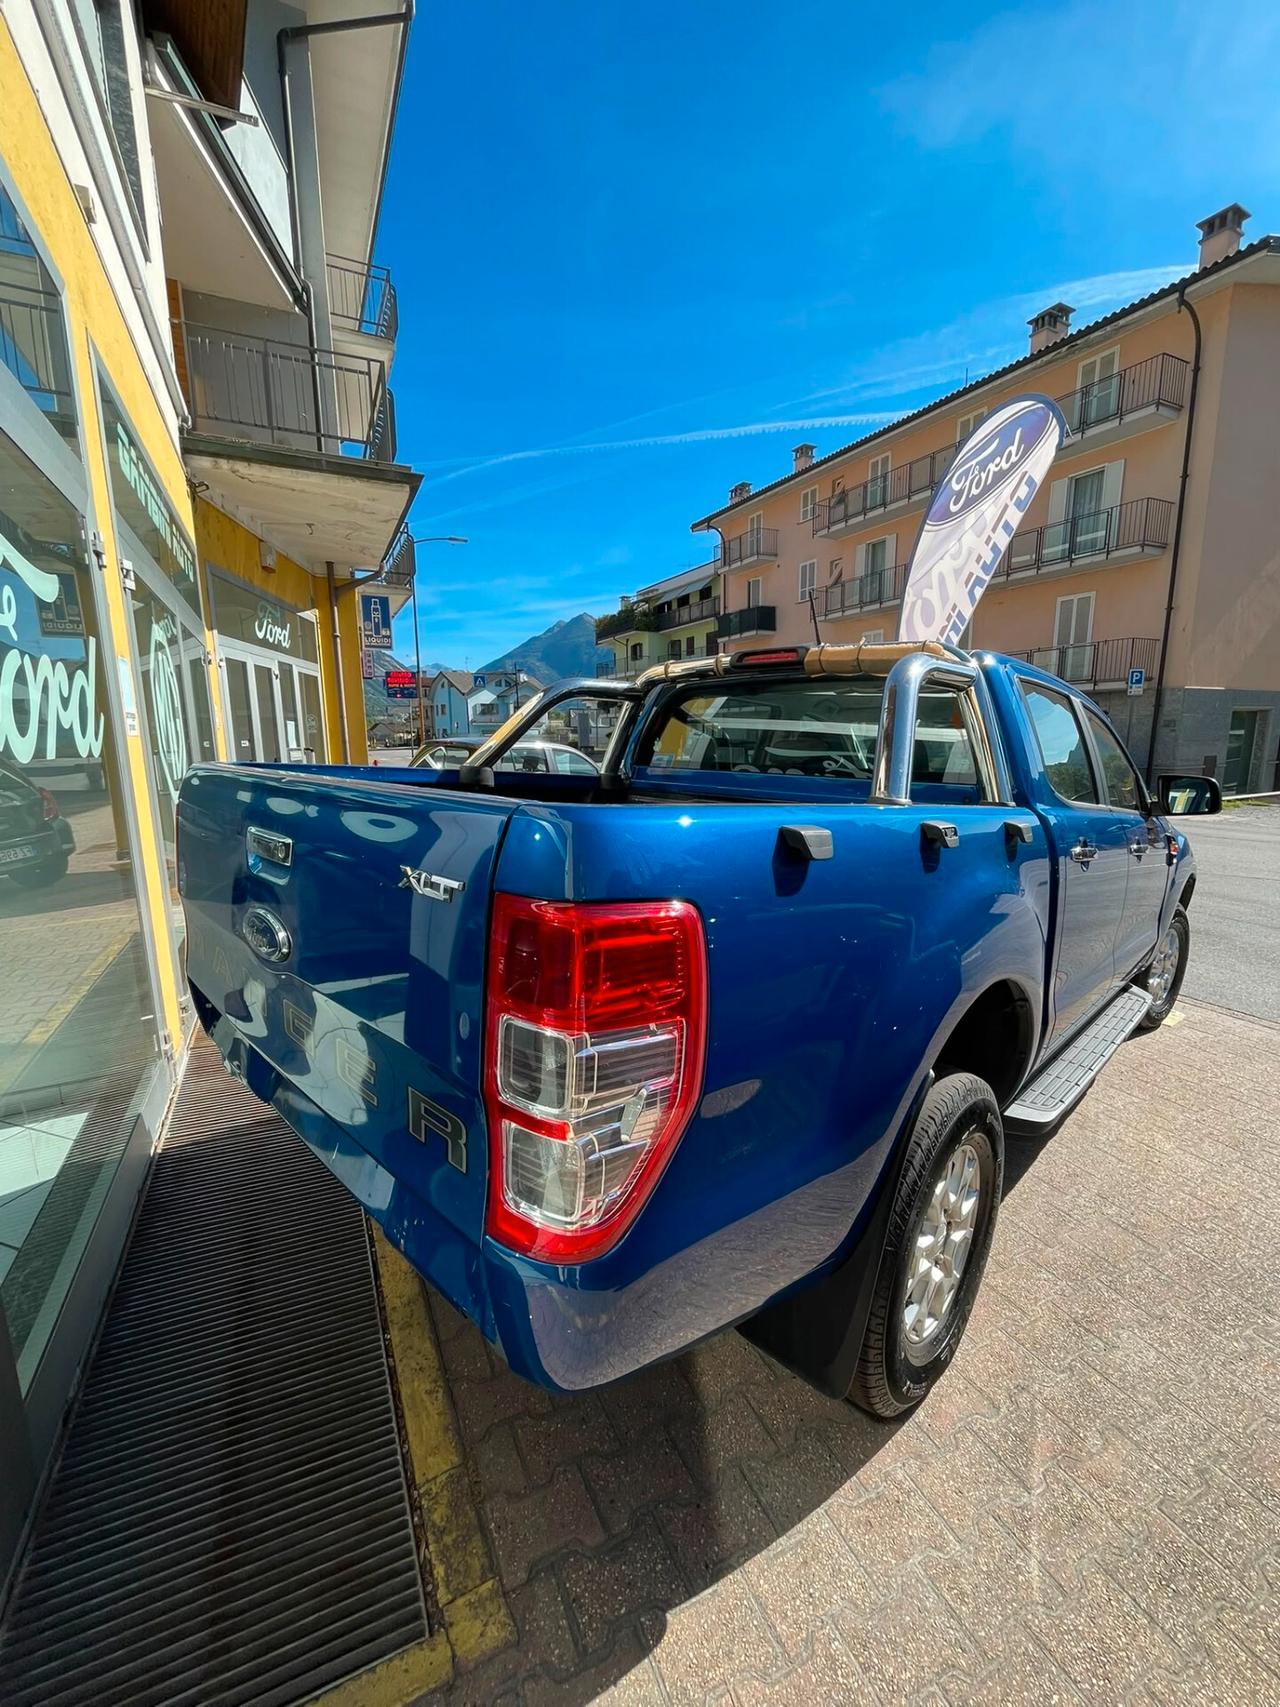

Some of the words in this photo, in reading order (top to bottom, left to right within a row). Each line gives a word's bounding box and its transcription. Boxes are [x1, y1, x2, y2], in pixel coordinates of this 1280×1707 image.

[950, 428, 1025, 513] Ford
[964, 471, 1038, 608] AUTO
[255, 601, 291, 649] Ford
[1133, 672, 1141, 683] P
[398, 865, 466, 904] XLT
[192, 930, 467, 1174] ANGER
